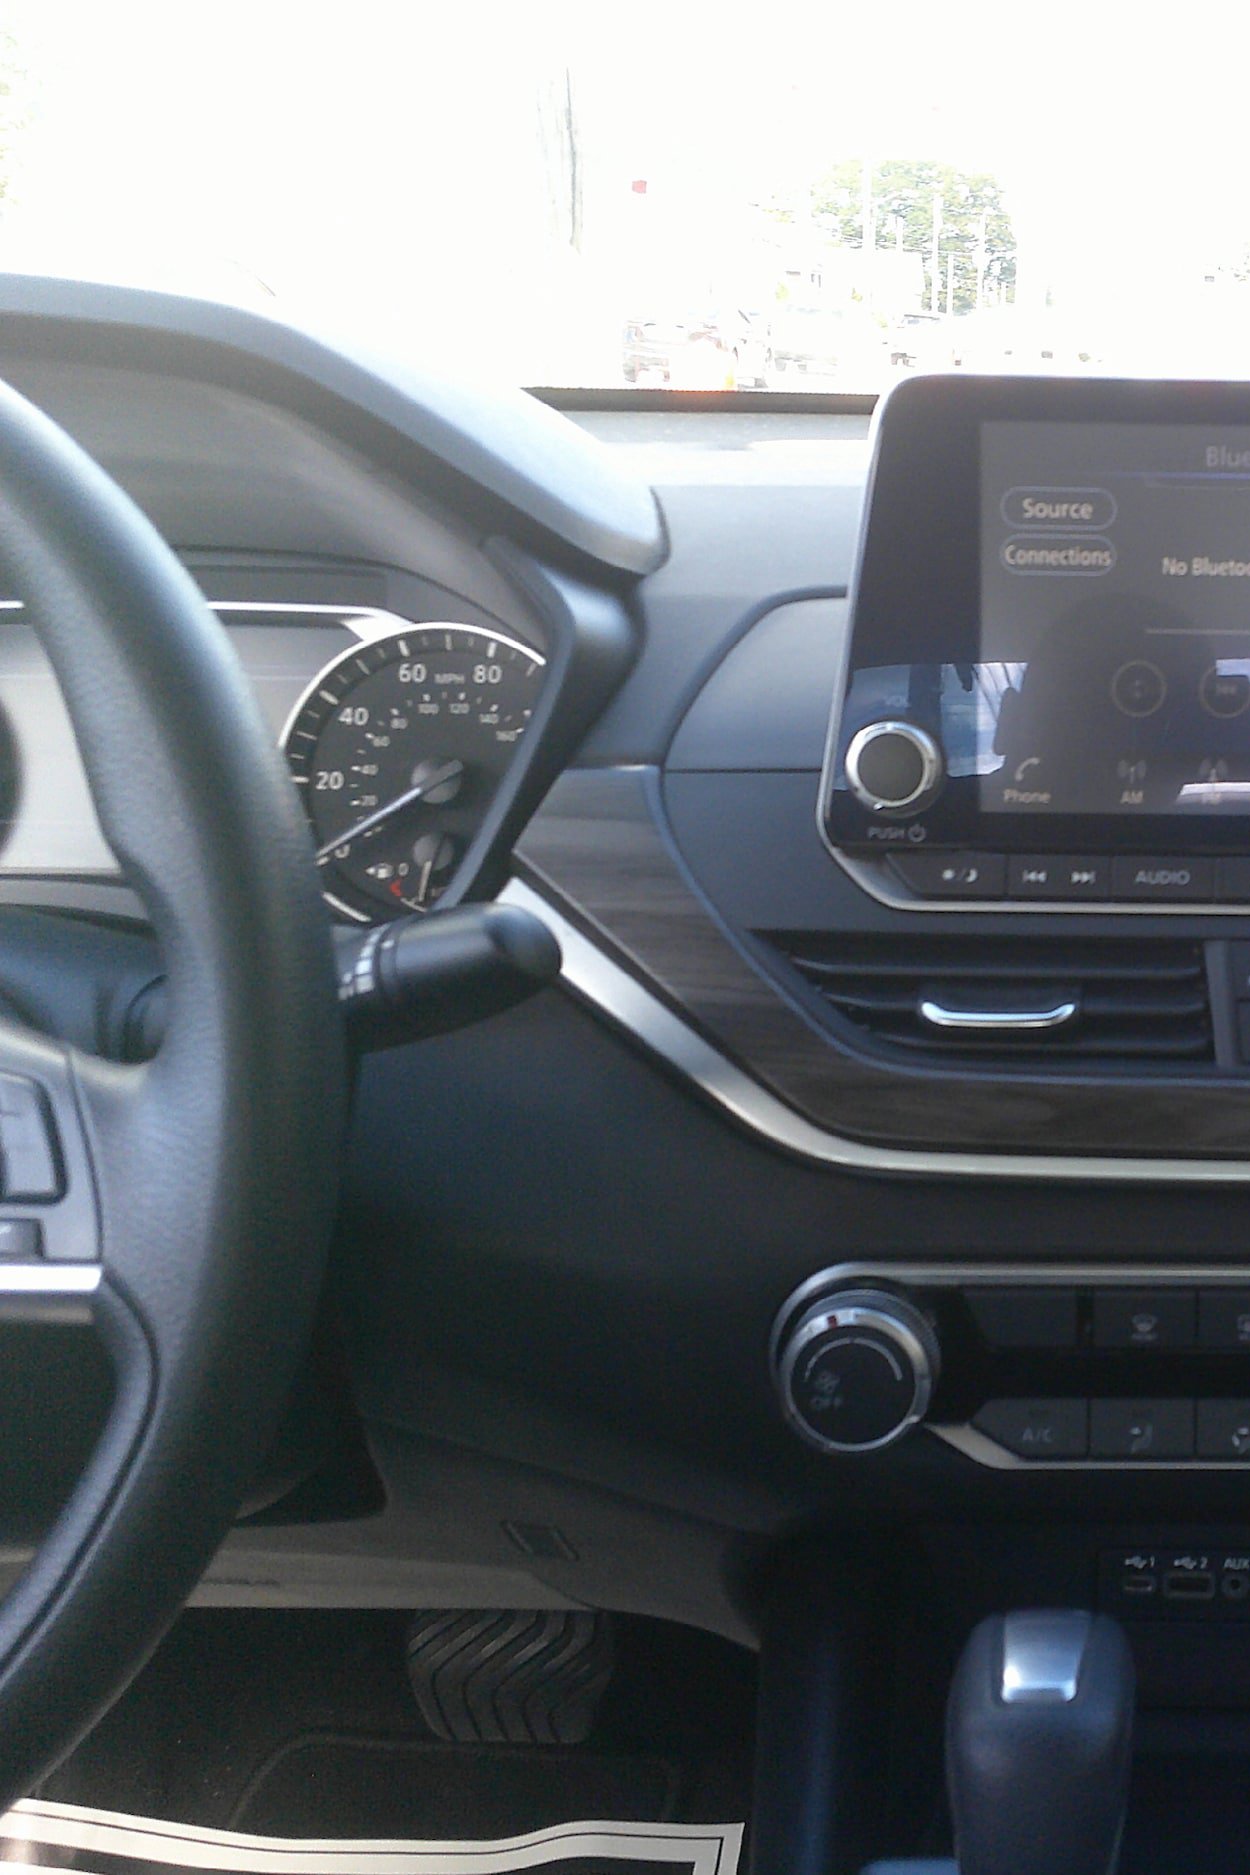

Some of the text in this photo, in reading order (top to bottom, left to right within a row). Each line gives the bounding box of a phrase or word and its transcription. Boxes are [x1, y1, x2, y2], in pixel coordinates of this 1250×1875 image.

[1022, 498, 1094, 521] Source
[1005, 543, 1113, 567] Connections
[1162, 557, 1188, 577] No
[398, 663, 427, 683] 60
[434, 673, 465, 684] MPH
[473, 665, 502, 684] 80
[339, 707, 369, 726] 40
[315, 771, 344, 791] 20
[1003, 788, 1051, 804] Phone
[1120, 789, 1144, 805] AM
[867, 826, 906, 840] PUSH
[1135, 869, 1190, 886] AUDIO
[1022, 1427, 1053, 1444] A/C
[1223, 1557, 1250, 1570] AUX
